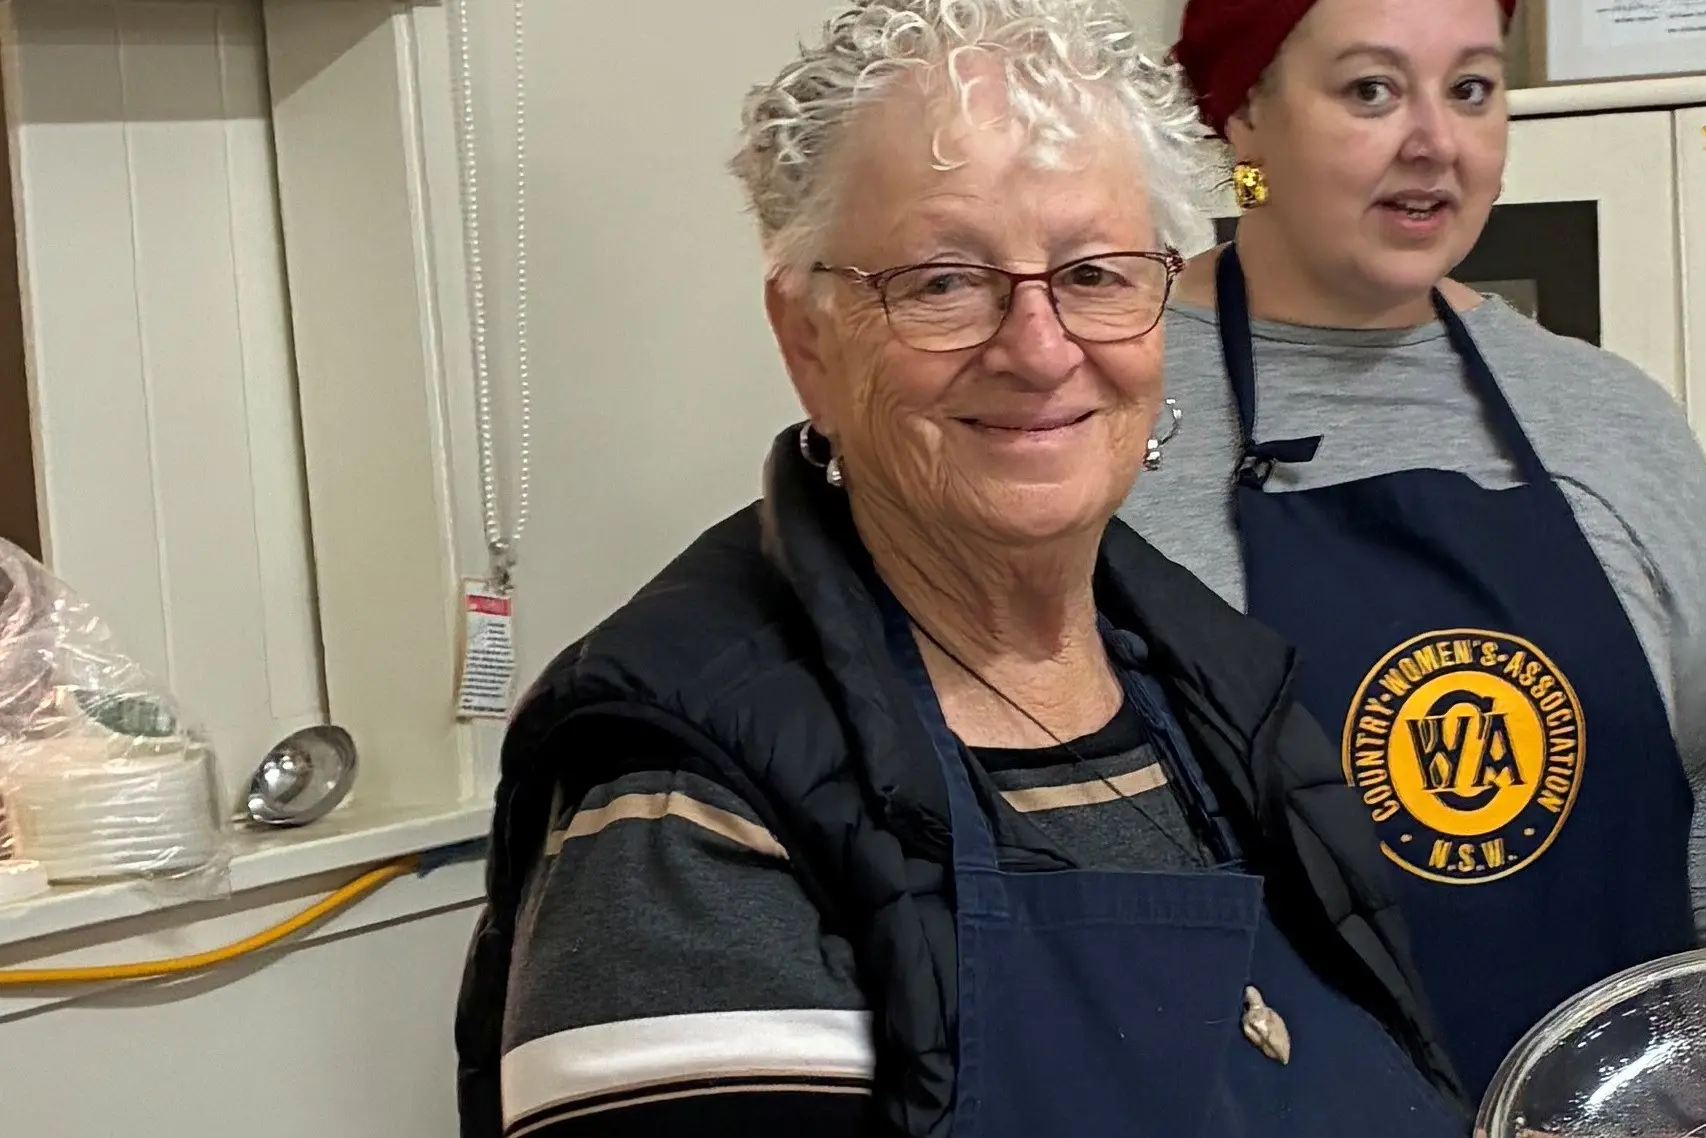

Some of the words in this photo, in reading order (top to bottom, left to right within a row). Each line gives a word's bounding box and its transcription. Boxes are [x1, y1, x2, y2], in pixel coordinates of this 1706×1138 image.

[1354, 697, 1400, 822] COUNTRY
[1379, 639, 1499, 696] WOMEN'S
[1503, 651, 1577, 813] ASSOCIATION
